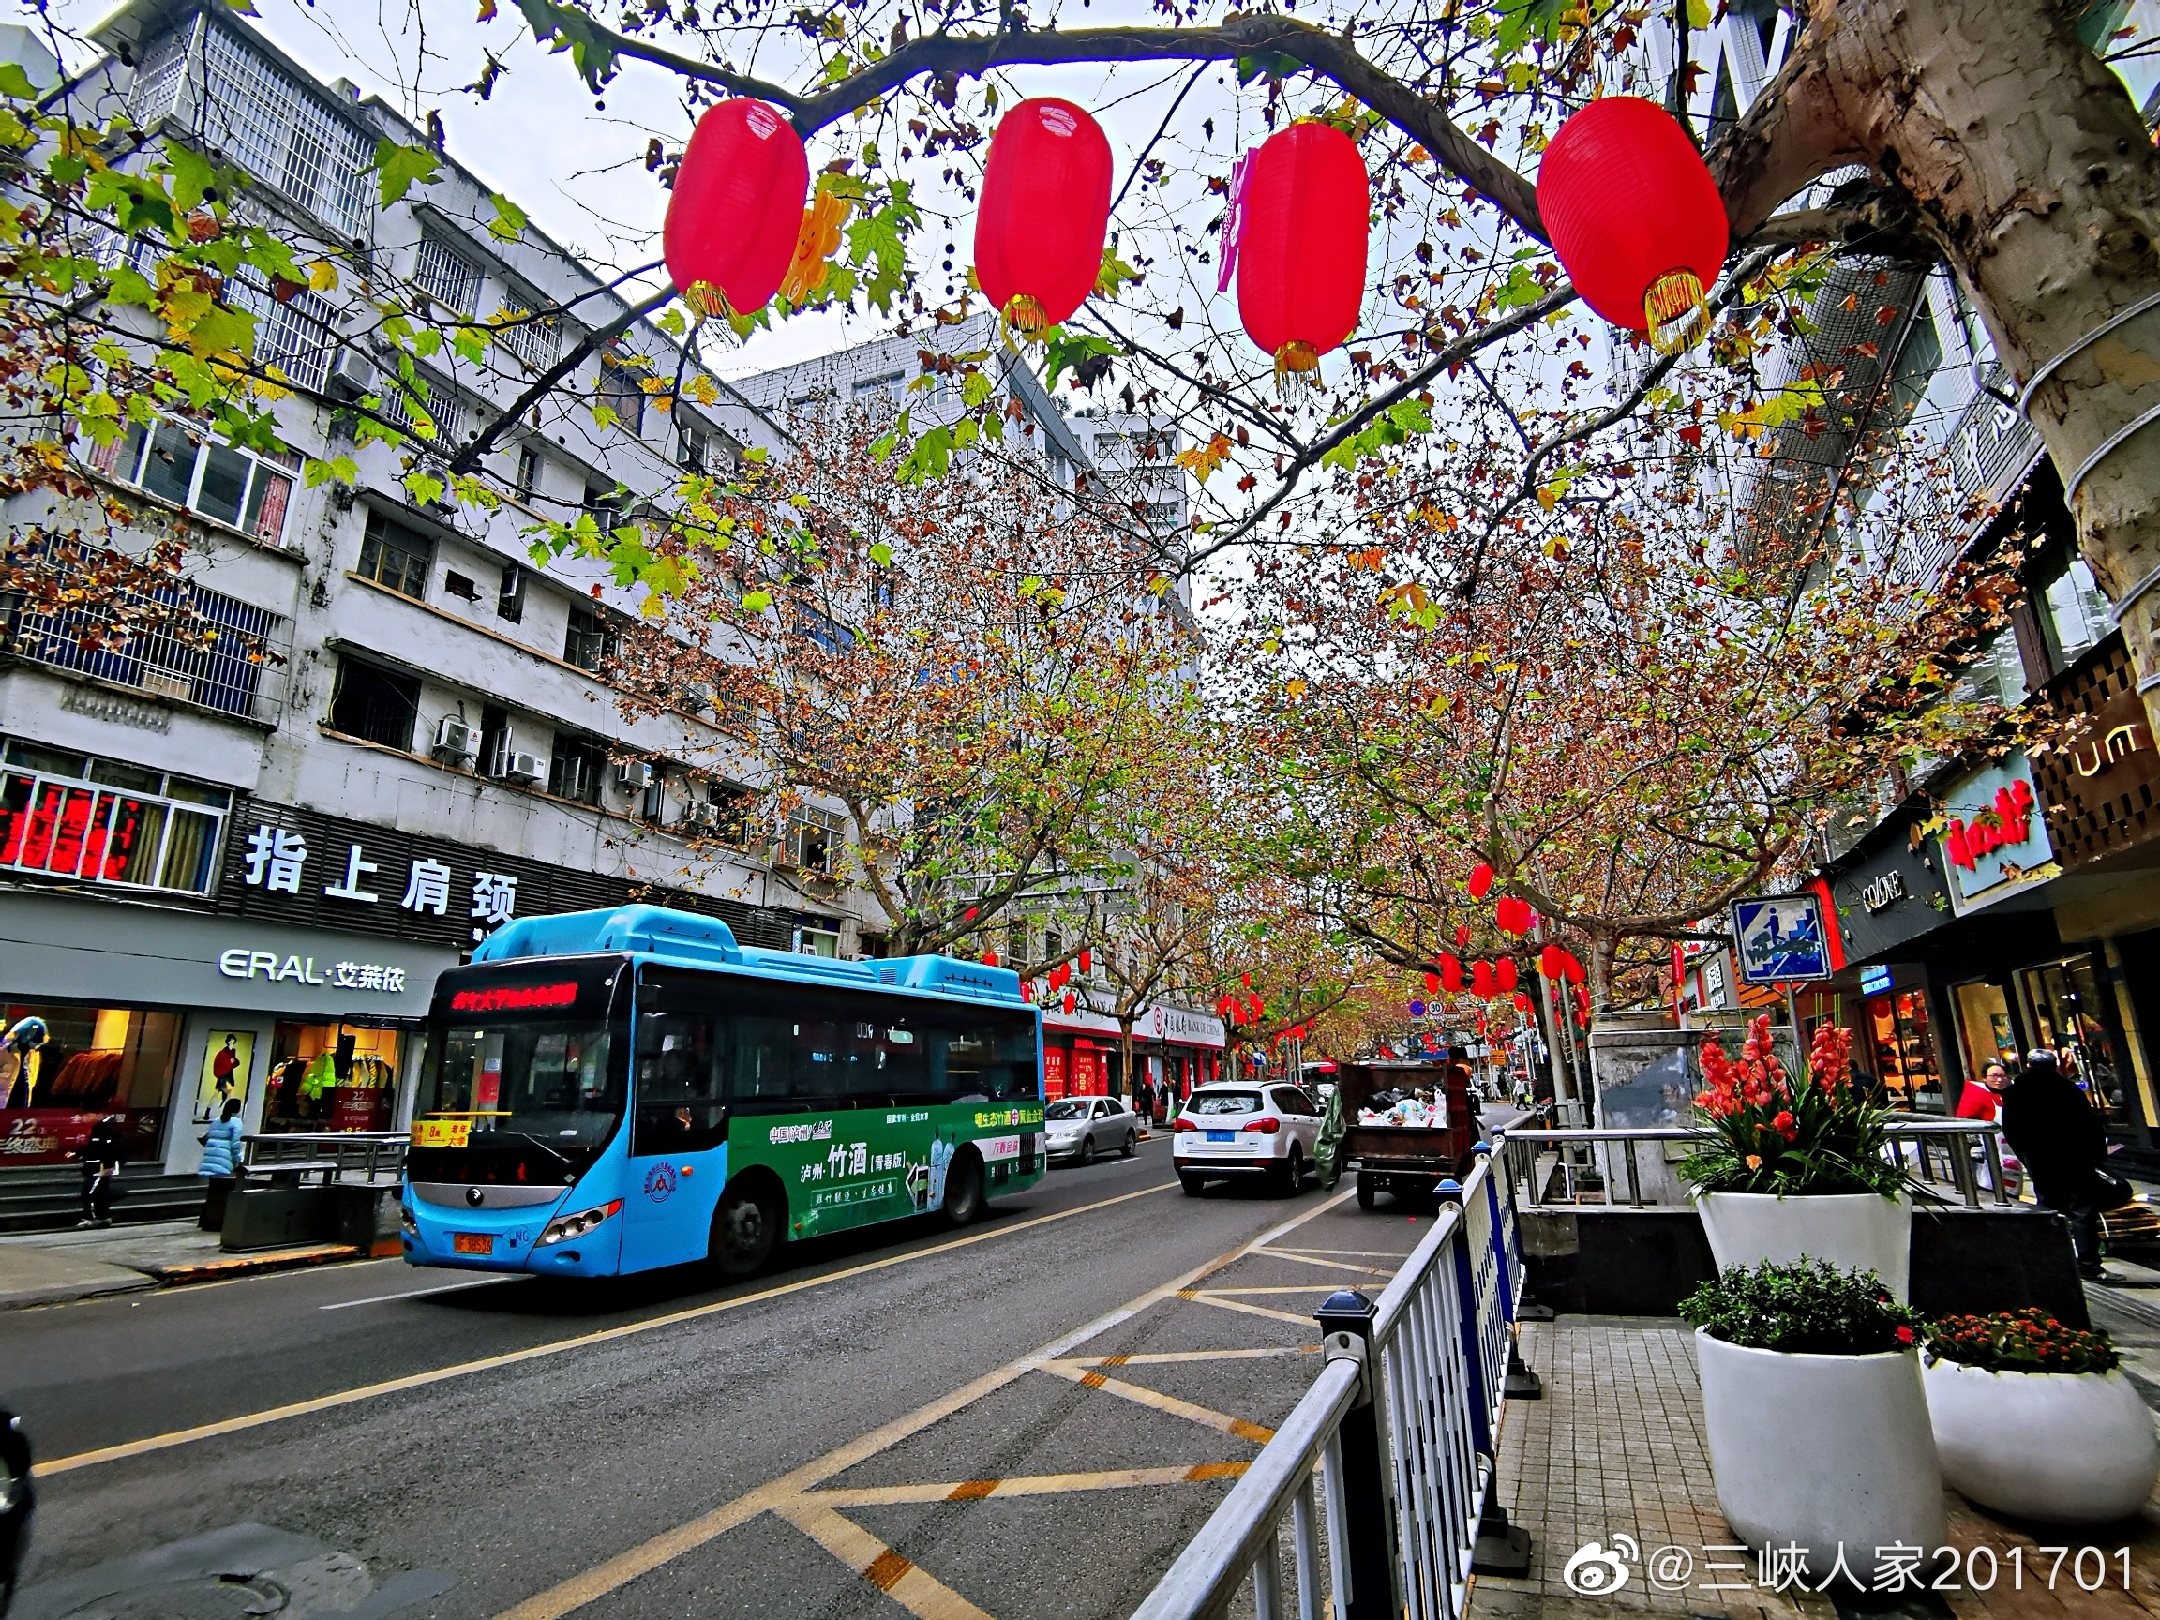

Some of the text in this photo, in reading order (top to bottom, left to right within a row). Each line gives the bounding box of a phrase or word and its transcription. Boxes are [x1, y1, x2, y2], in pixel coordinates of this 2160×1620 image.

[244, 824, 520, 924] 指上肩颈
[220, 949, 406, 992] ERAL 艾莱依
[1430, 1002, 1441, 1013] 30
